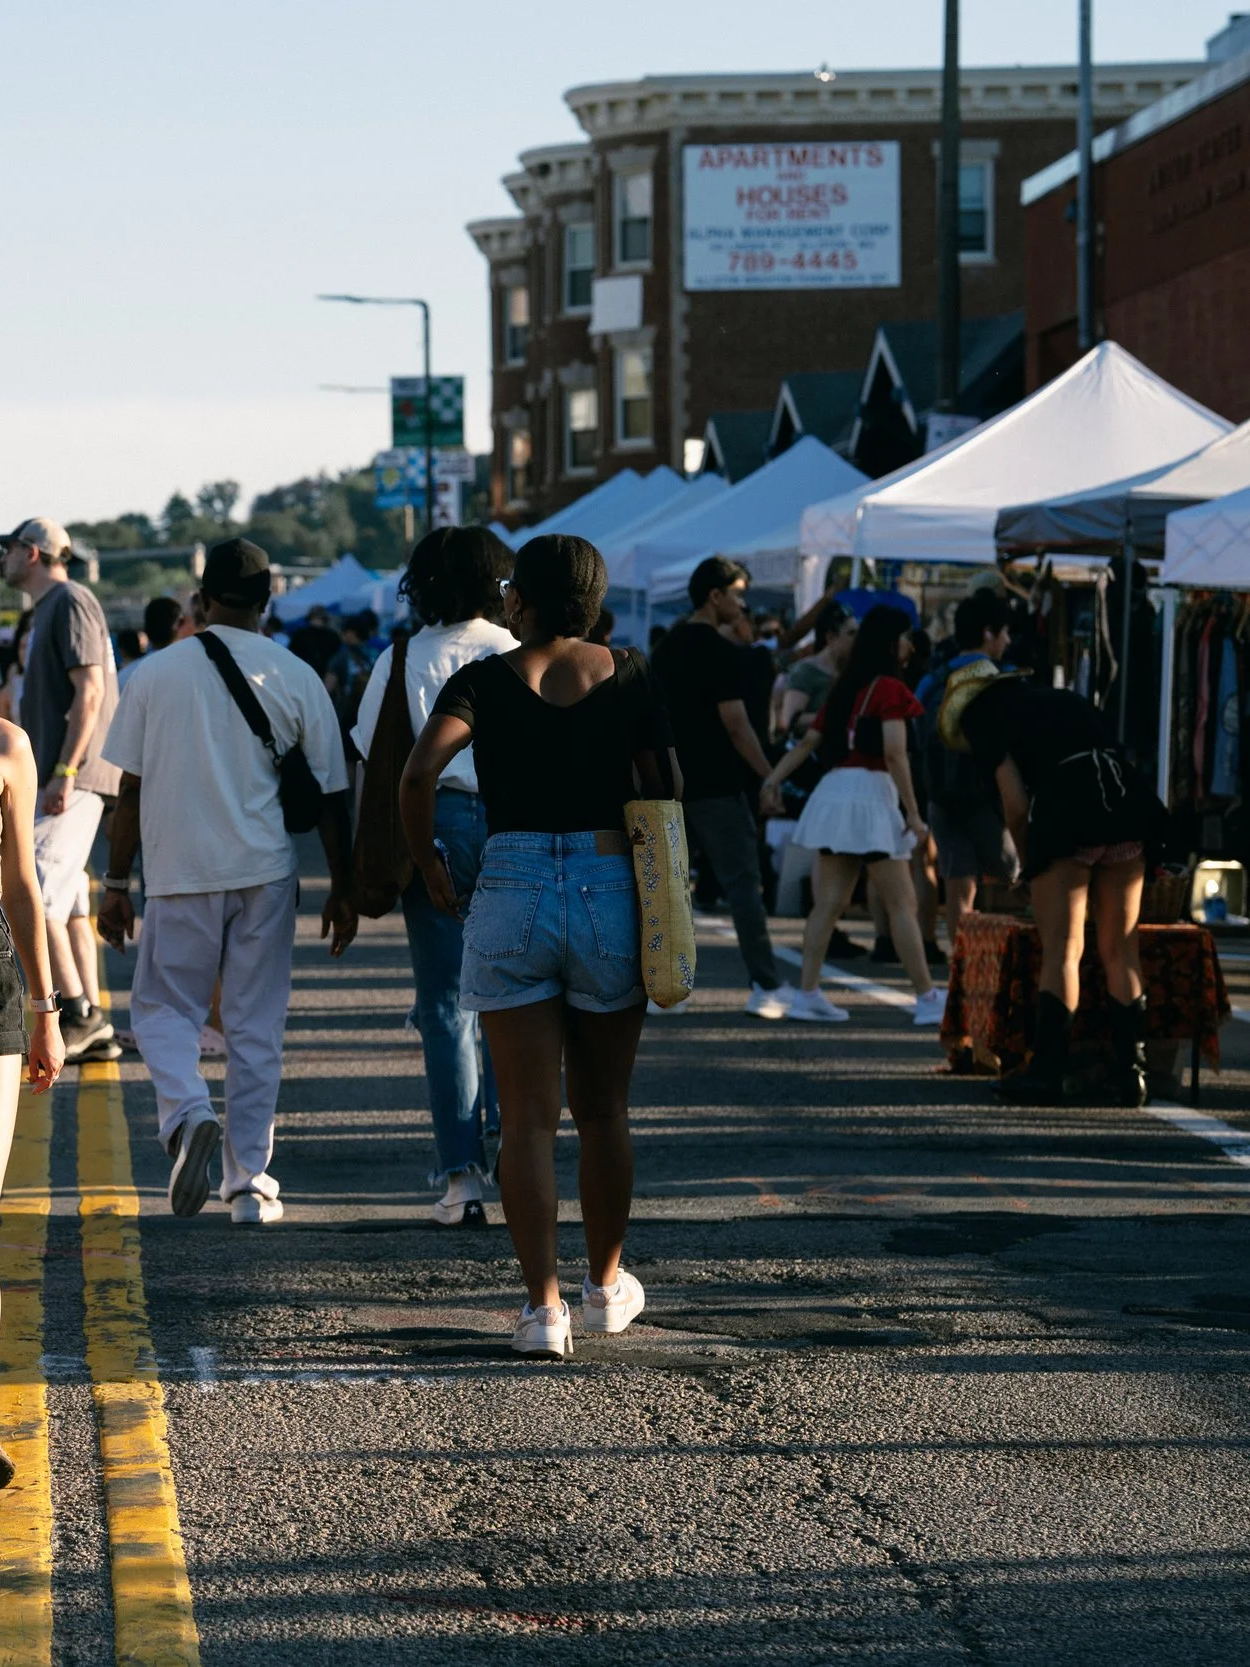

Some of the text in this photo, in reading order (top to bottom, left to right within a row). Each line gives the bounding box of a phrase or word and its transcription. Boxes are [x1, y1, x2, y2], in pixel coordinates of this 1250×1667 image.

[699, 144, 884, 169] APARTMENTS
[736, 183, 849, 207] HOUSES
[728, 250, 857, 271] 789-4445
